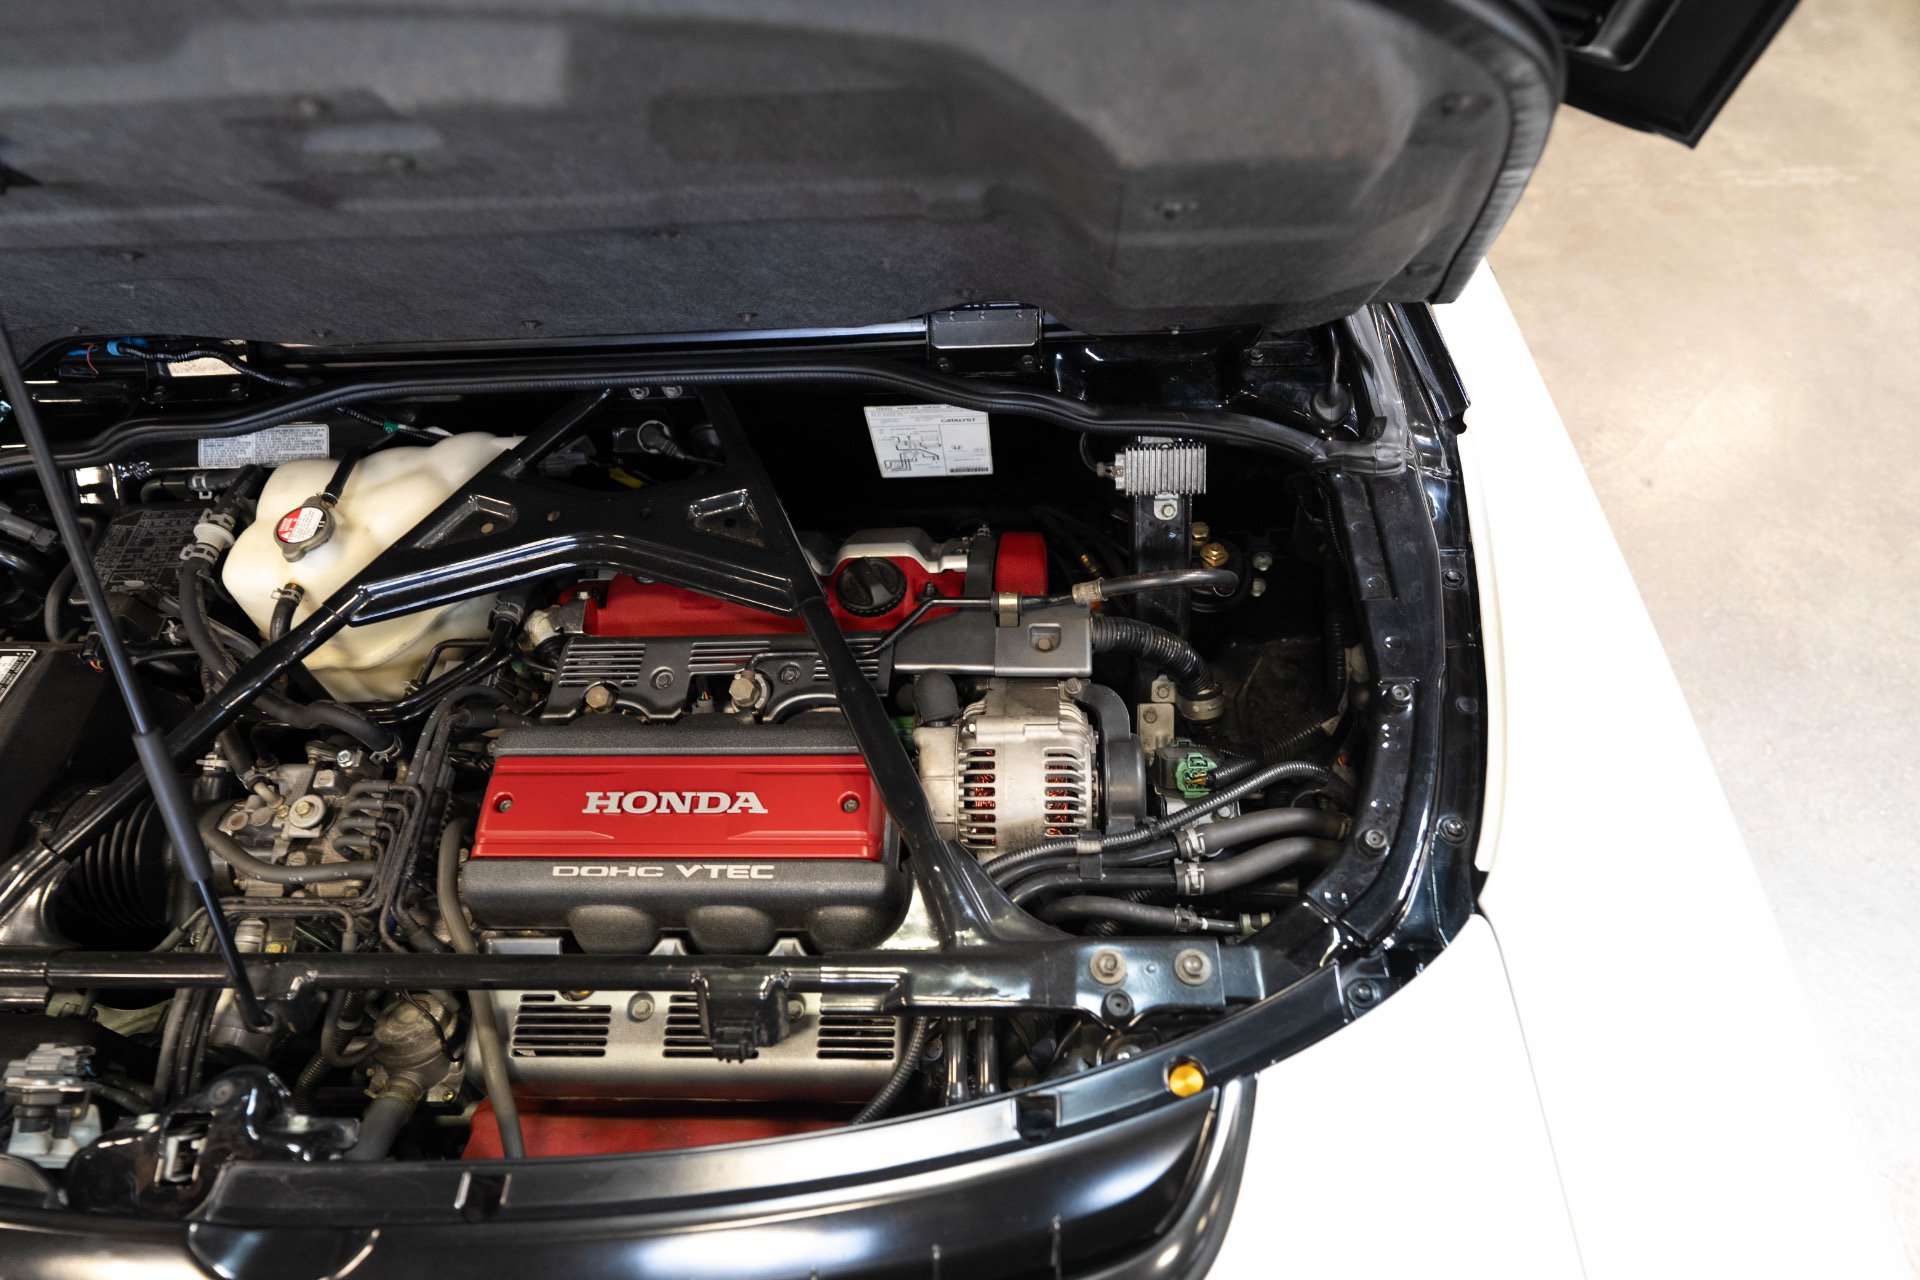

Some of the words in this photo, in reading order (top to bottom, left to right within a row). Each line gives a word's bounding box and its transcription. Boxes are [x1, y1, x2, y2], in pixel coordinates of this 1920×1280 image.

[582, 791, 768, 814] HONDA
[552, 865, 664, 878] DOHC
[675, 864, 774, 879] VTEC
